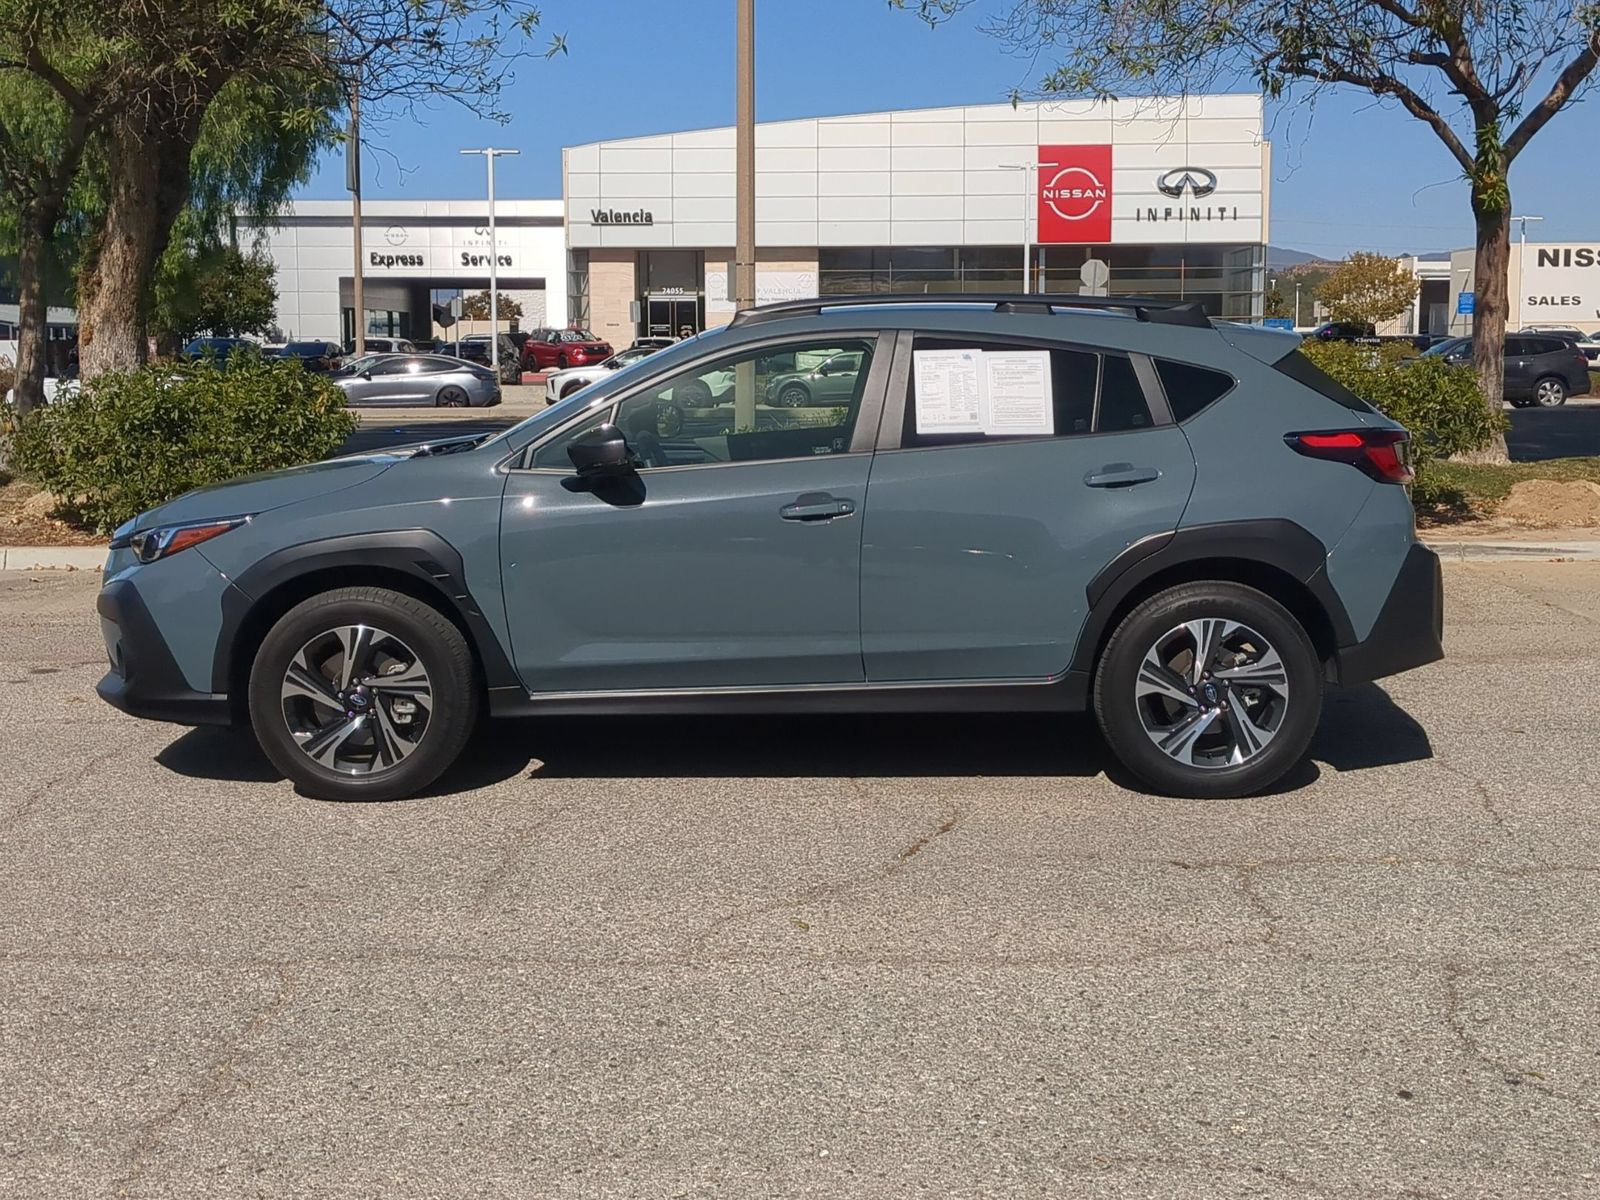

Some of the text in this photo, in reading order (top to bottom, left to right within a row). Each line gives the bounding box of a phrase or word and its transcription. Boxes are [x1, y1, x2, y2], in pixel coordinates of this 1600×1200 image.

[1043, 189, 1106, 199] NISSAN
[591, 208, 653, 223] Valencia
[1136, 207, 1238, 222] INFINITI
[463, 239, 508, 247] INFINTI
[370, 252, 513, 268] Express Servce
[1537, 248, 1600, 268] NIS
[1527, 295, 1582, 306] SALES
